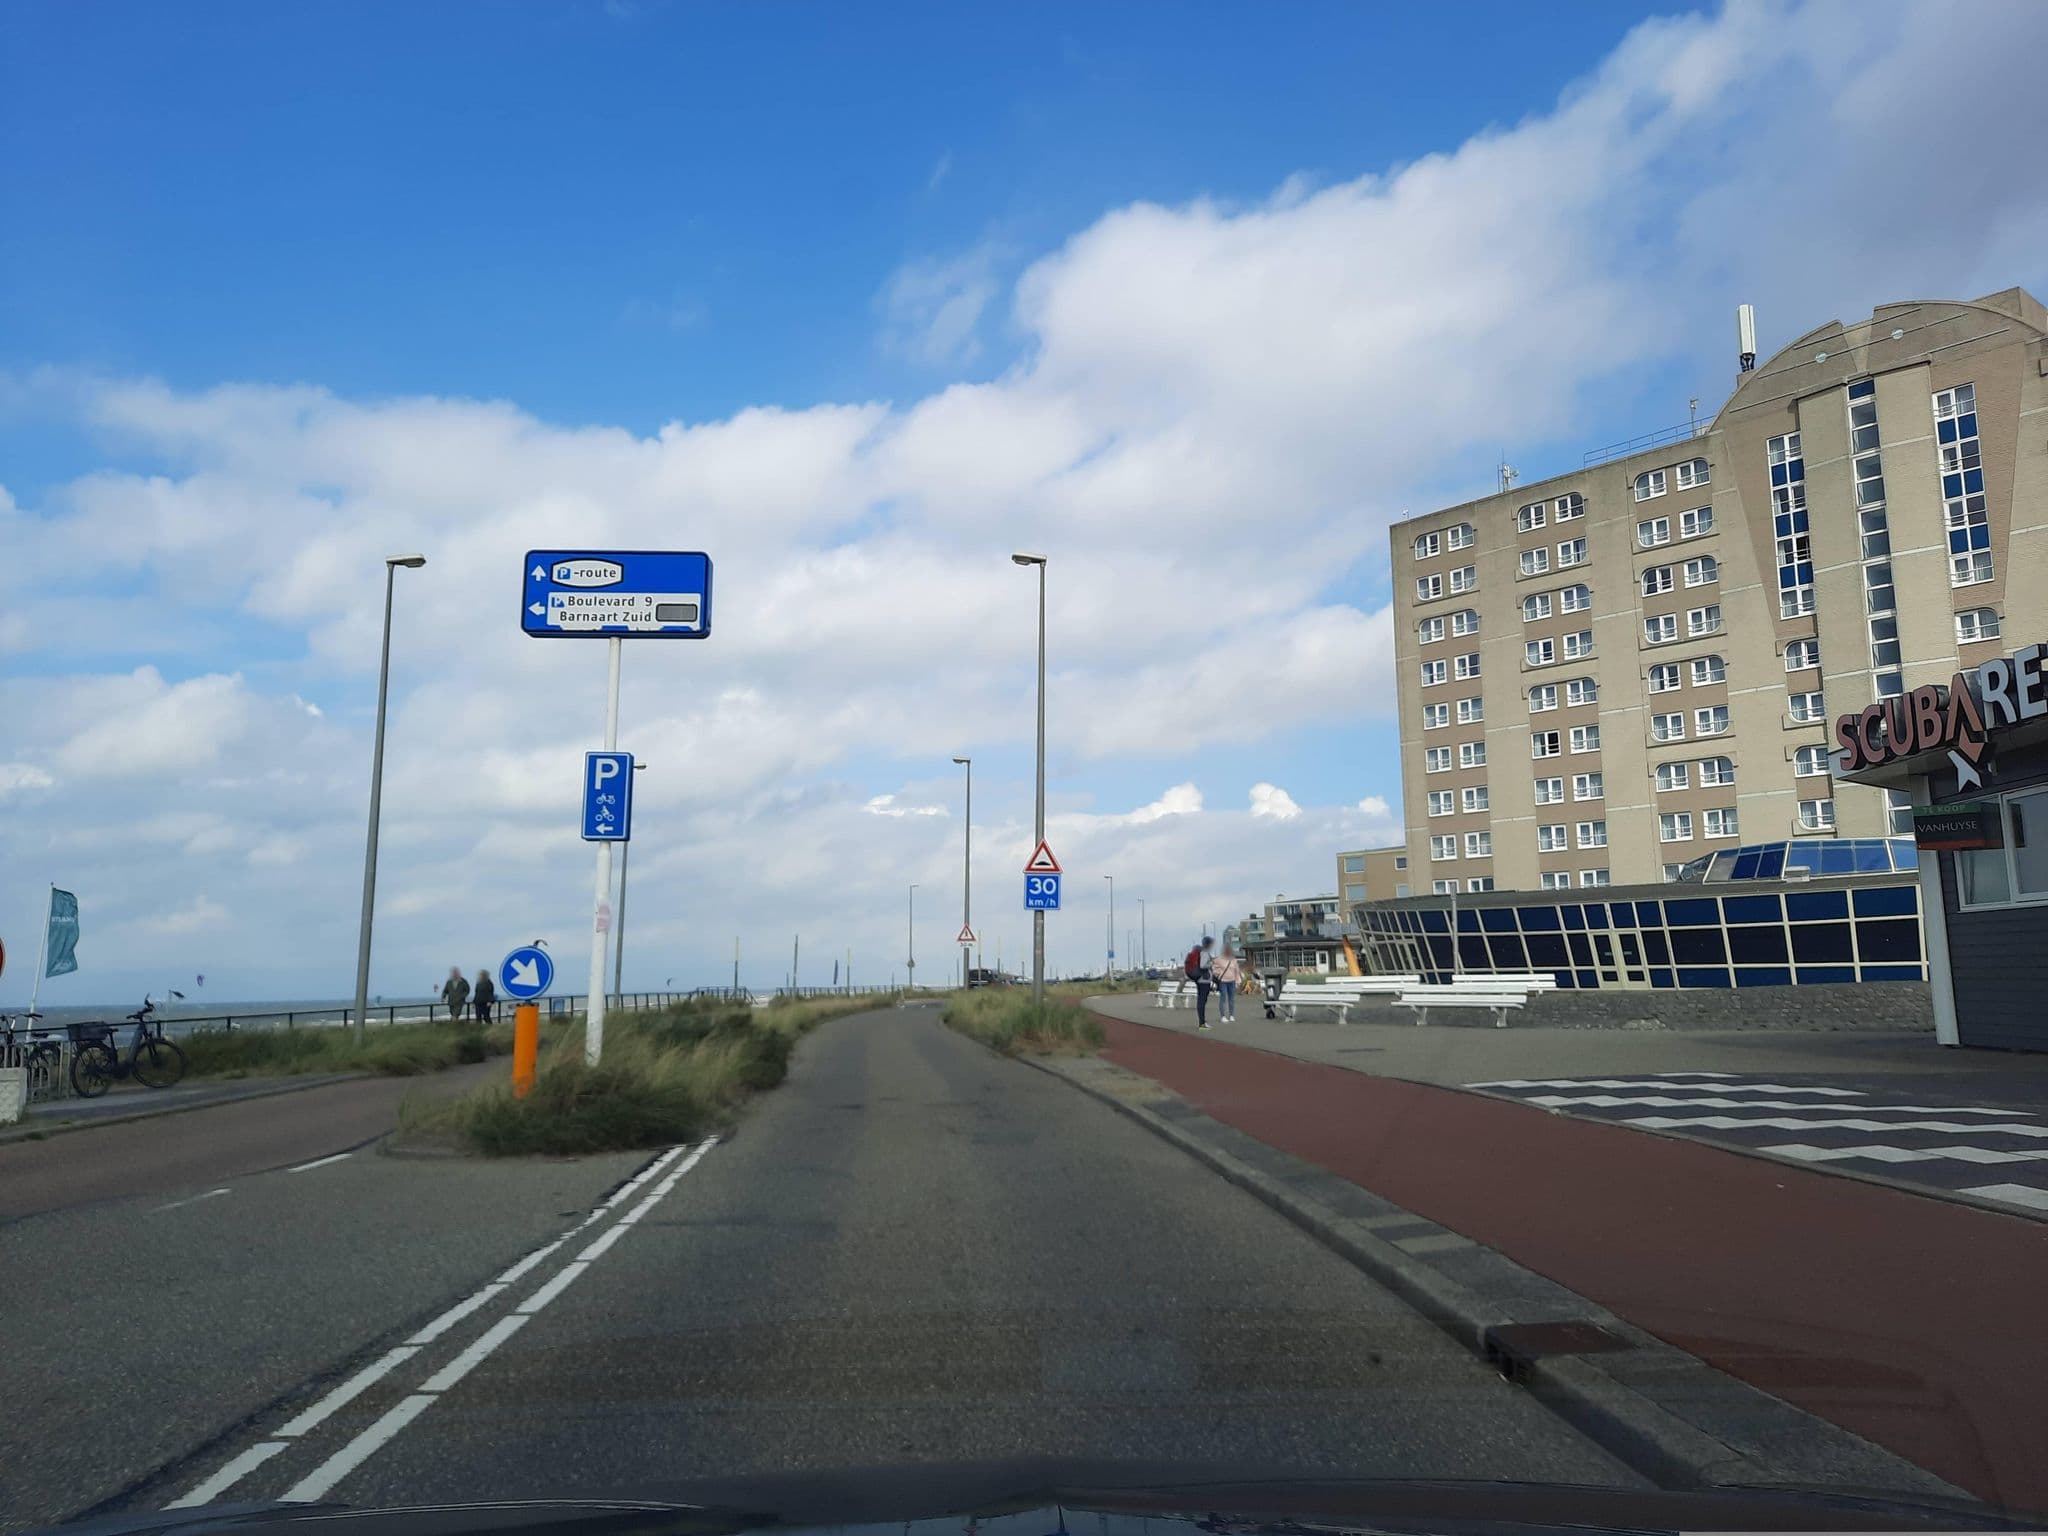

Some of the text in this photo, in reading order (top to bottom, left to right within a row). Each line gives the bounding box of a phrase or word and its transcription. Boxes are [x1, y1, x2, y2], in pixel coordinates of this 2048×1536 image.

[568, 596, 635, 607] Boulevard
[645, 596, 653, 607] 9
[560, 611, 652, 622] Barnaart Zuid
[594, 758, 620, 790] P
[1917, 821, 1977, 833] VANHUYSE
[1029, 878, 1056, 895] 30
[1028, 897, 1056, 907] km/h
